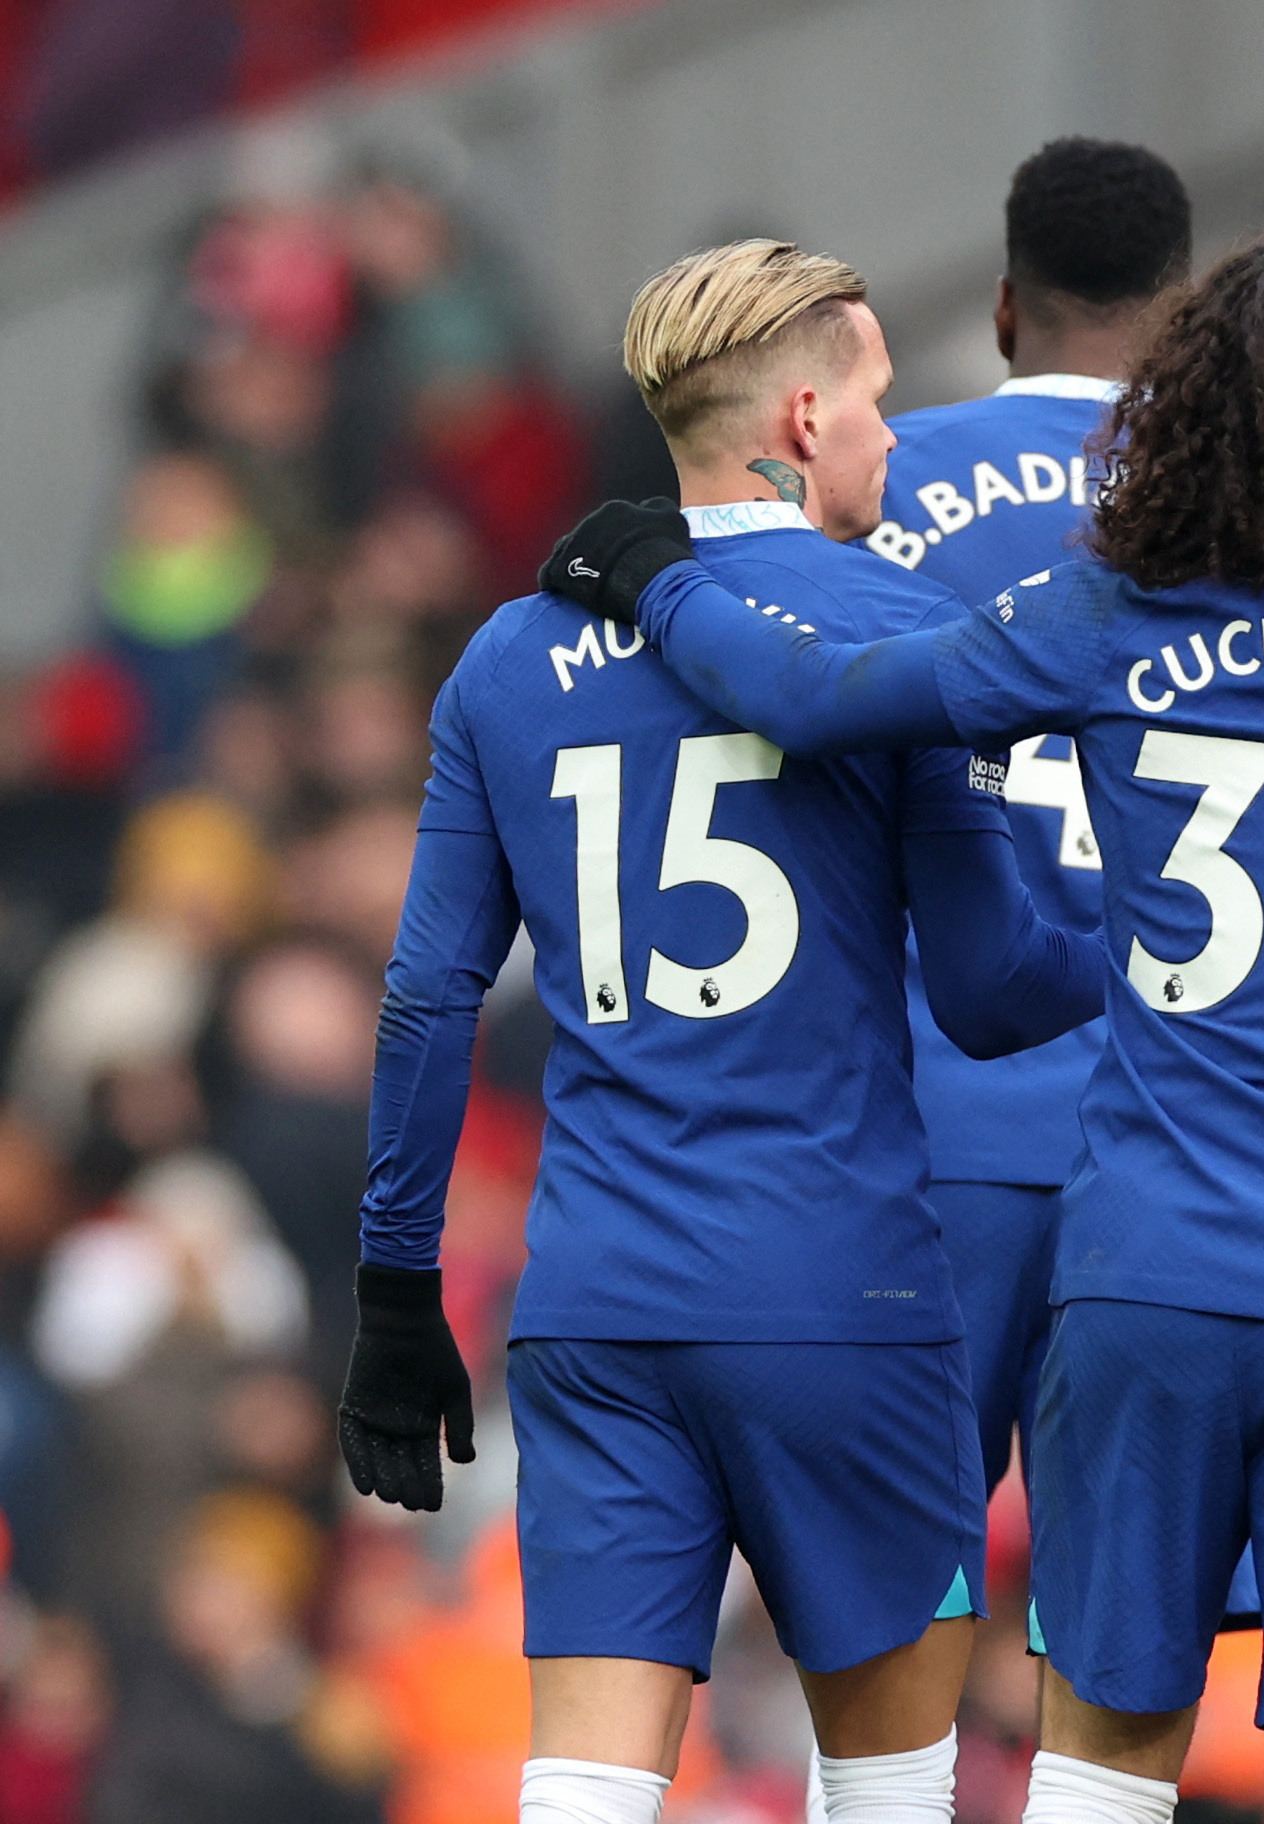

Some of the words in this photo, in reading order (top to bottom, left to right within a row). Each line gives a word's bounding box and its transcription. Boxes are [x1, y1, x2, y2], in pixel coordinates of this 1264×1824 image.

[866, 453, 1130, 571] B.BADI
[968, 754, 988, 776] No
[1005, 733, 1103, 870] 4
[549, 733, 800, 1024] 15
